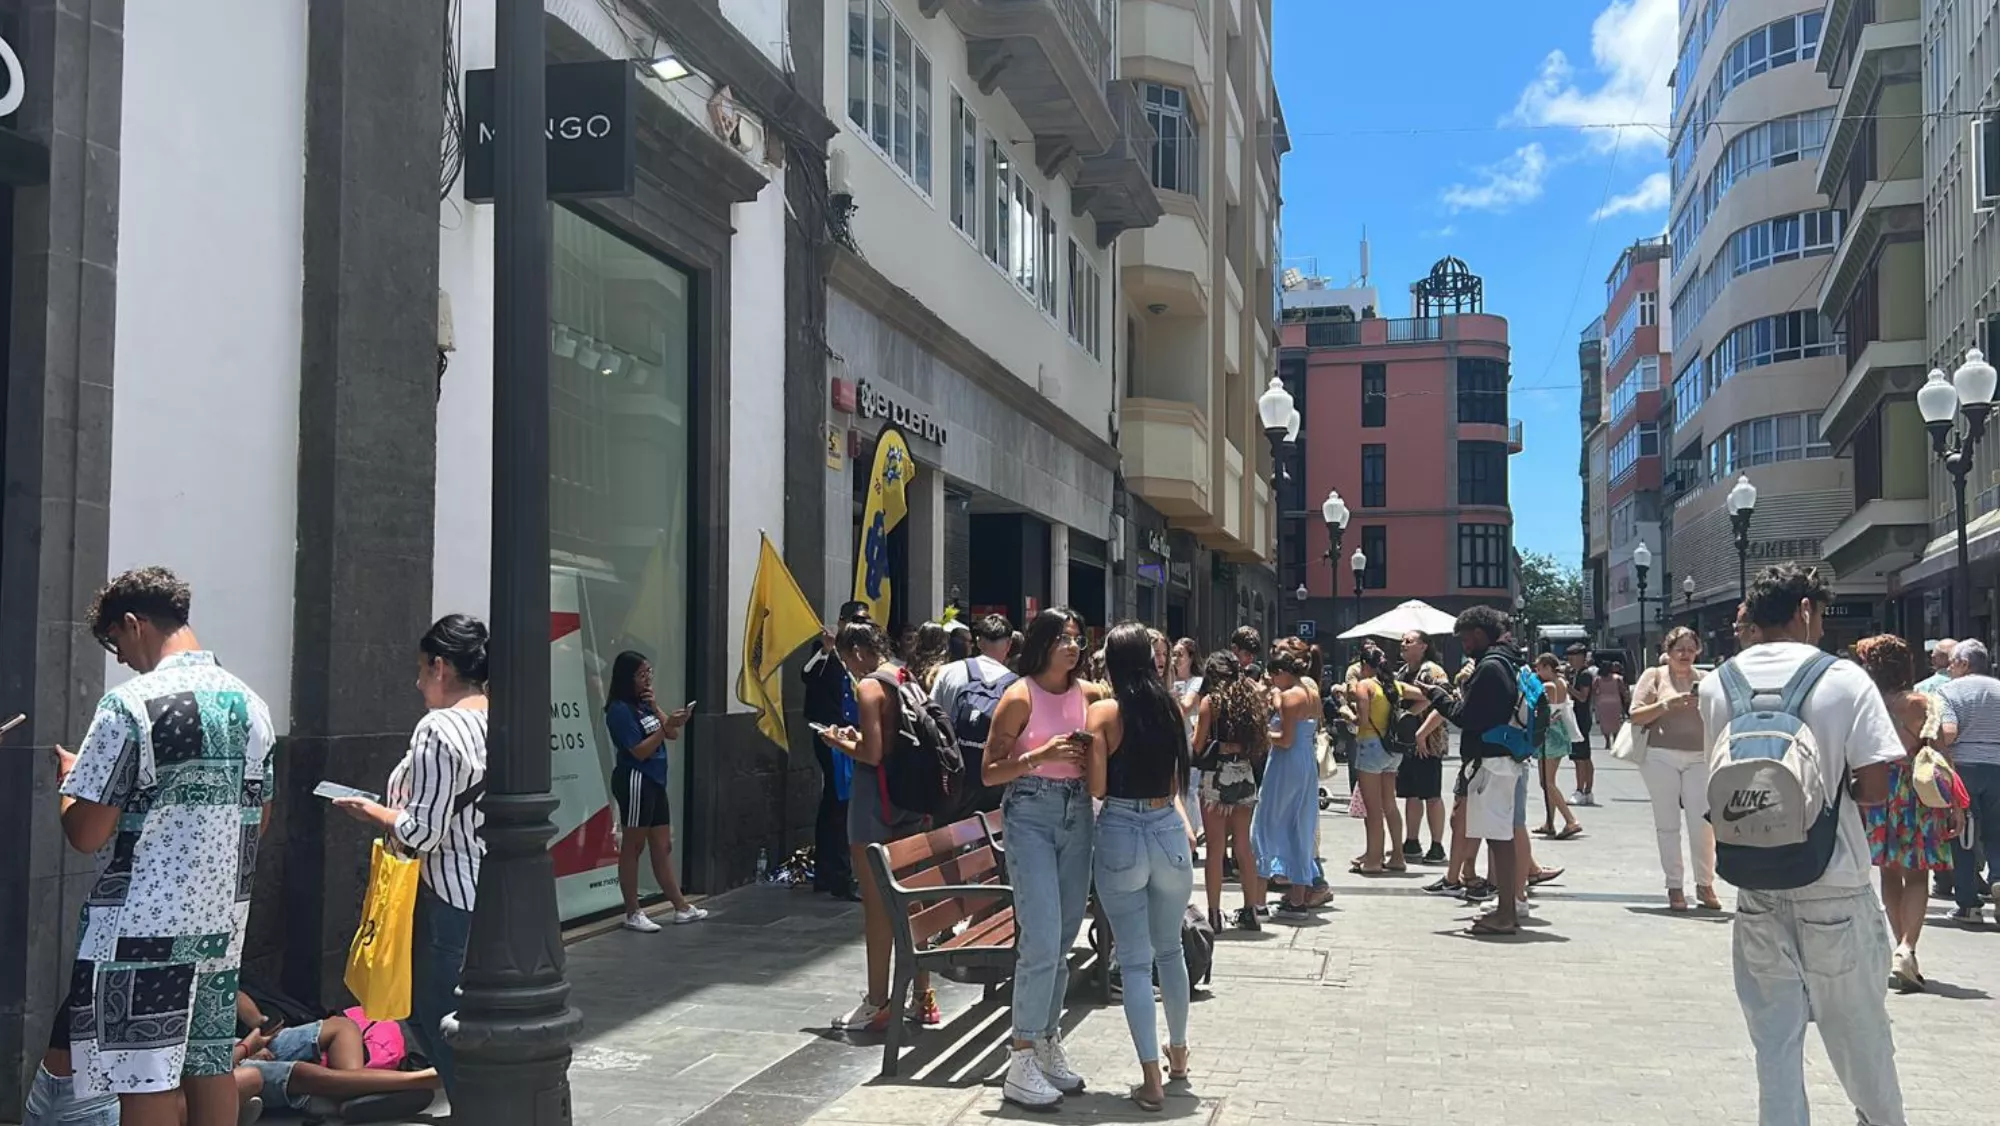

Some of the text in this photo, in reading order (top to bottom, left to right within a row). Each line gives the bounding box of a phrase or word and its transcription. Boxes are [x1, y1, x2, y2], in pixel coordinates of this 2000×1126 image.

[479, 115, 611, 144] MGO
[1300, 624, 1309, 635] P
[1731, 790, 1770, 810] NIKE
